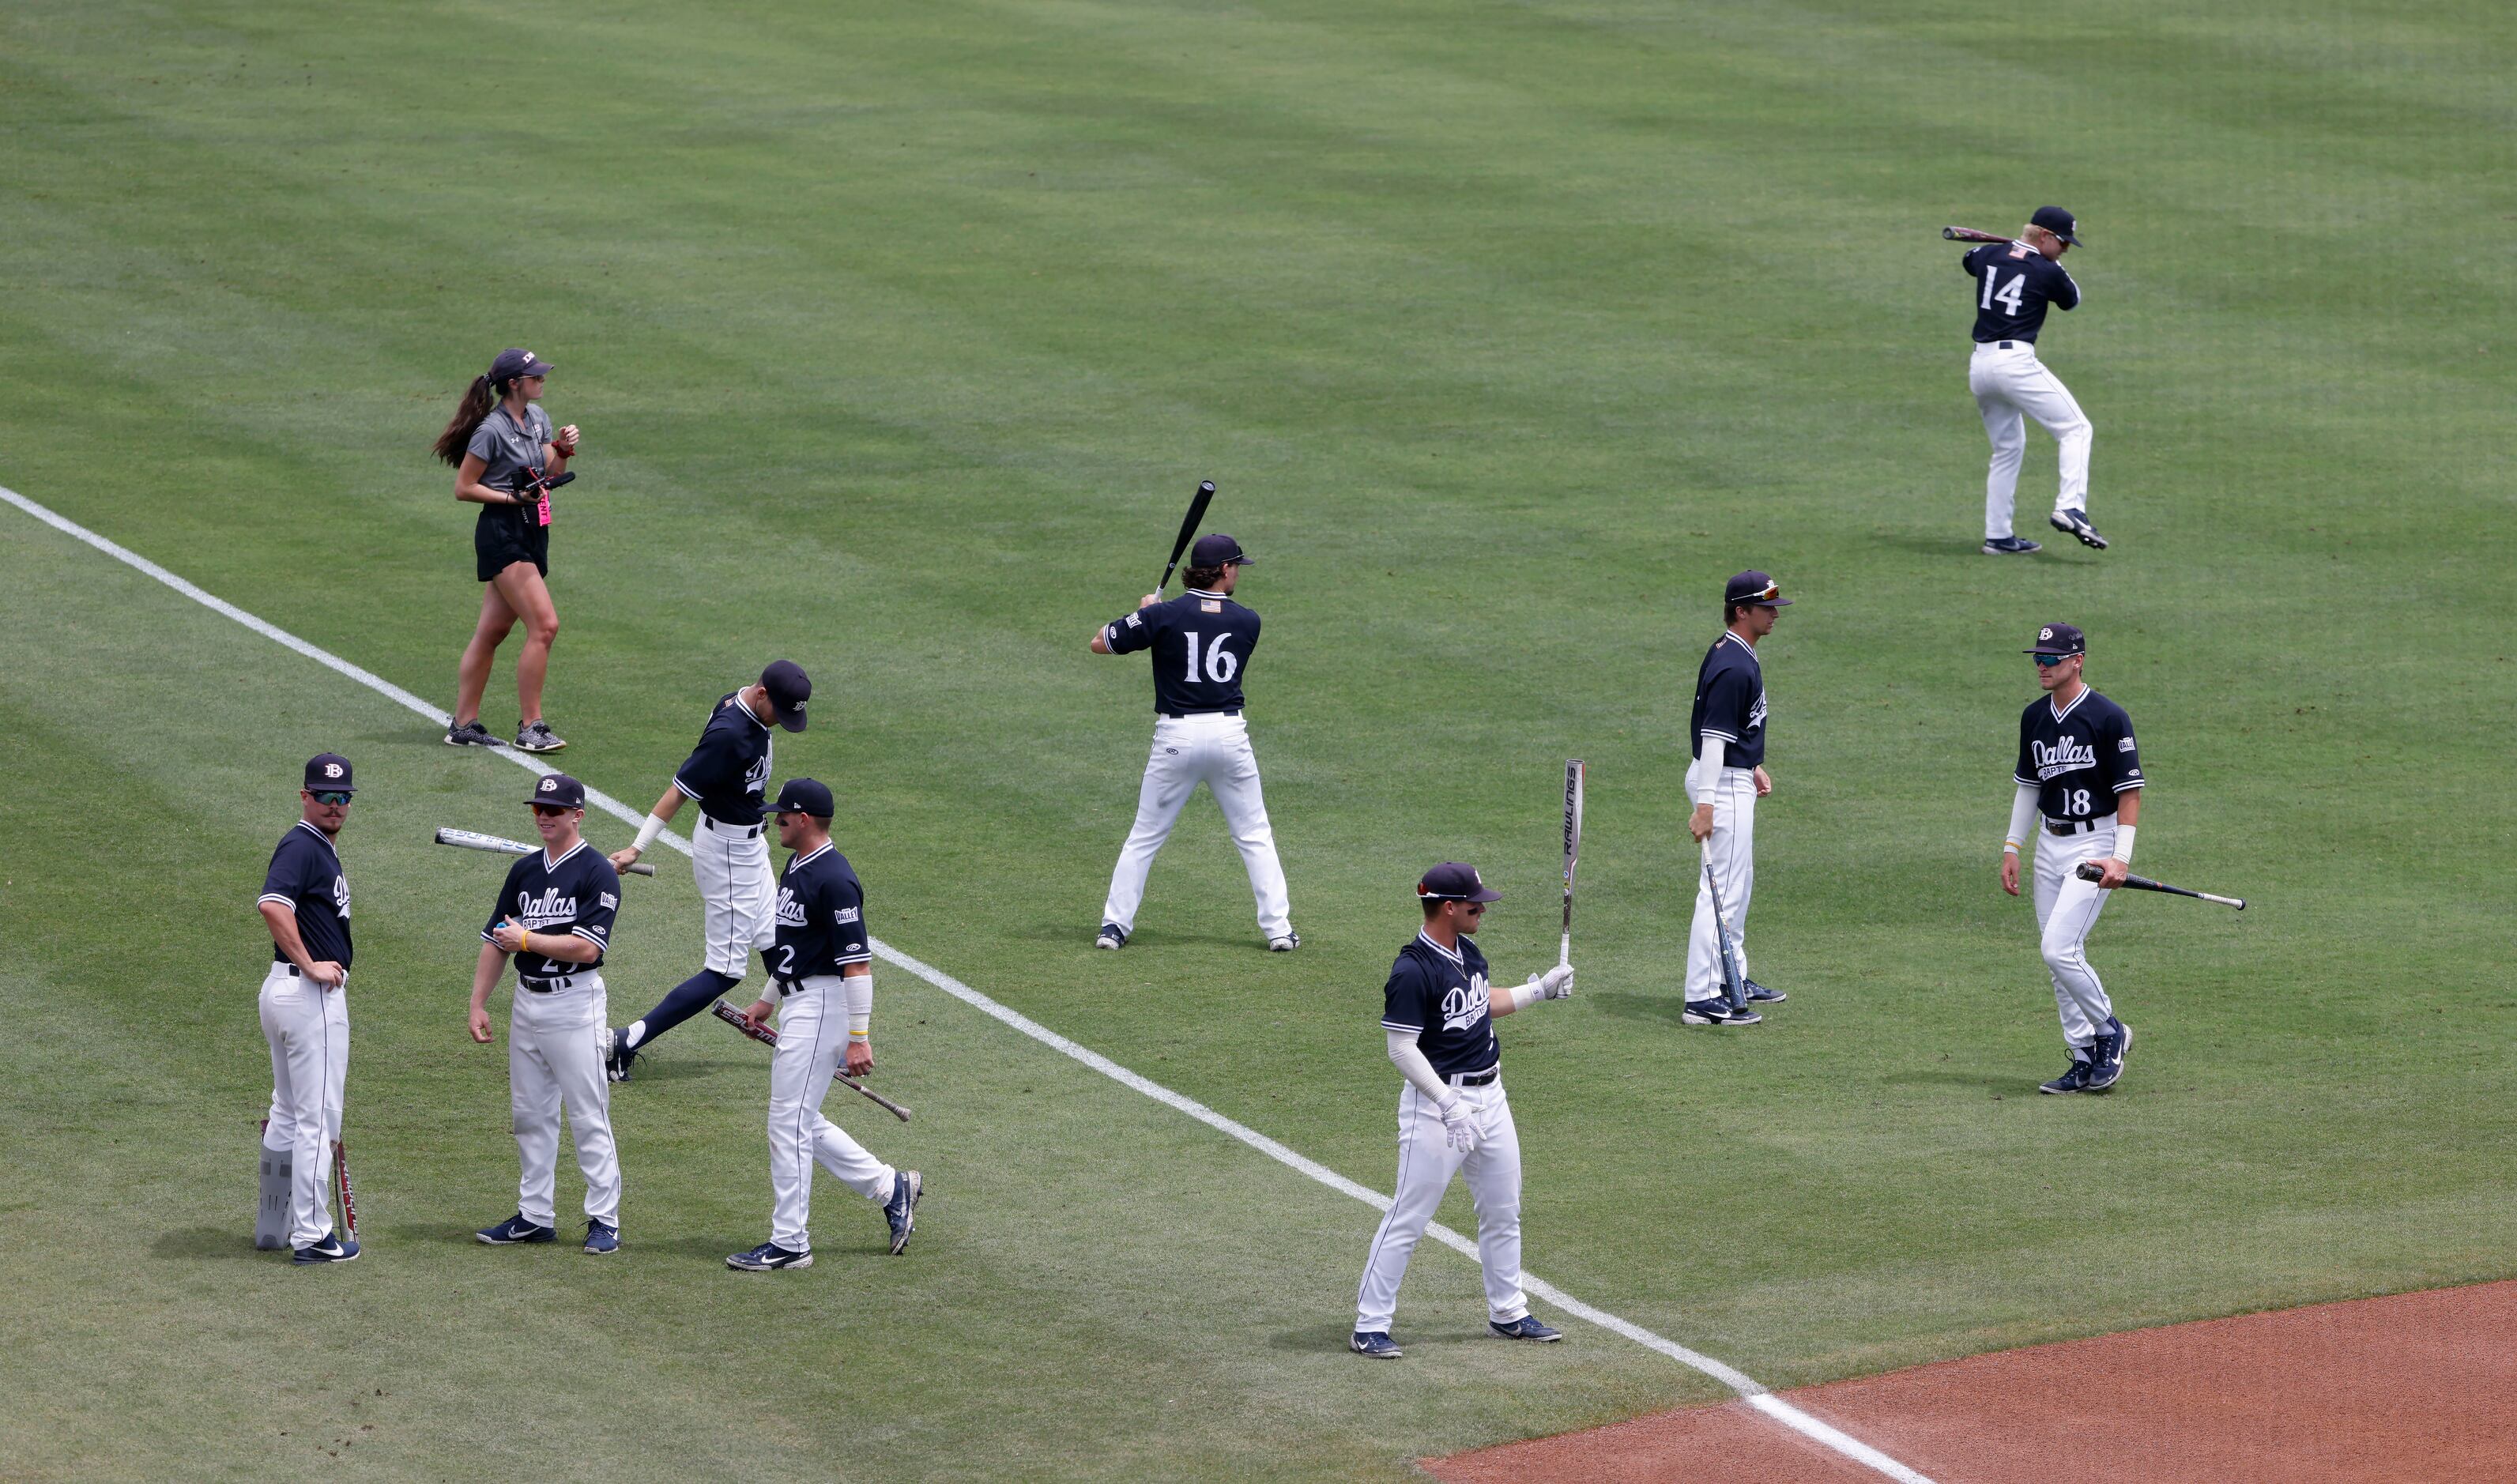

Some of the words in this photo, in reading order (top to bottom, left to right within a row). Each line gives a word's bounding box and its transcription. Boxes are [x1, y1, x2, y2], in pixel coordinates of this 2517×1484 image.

[1980, 265, 2025, 316] 14
[1184, 632, 1238, 683] 16
[2032, 736, 2094, 768] Dallas
[1565, 766, 1576, 855] RAWLINGS
[2062, 788, 2091, 815] 18
[518, 887, 577, 917] Dallas
[778, 945, 795, 974] 2
